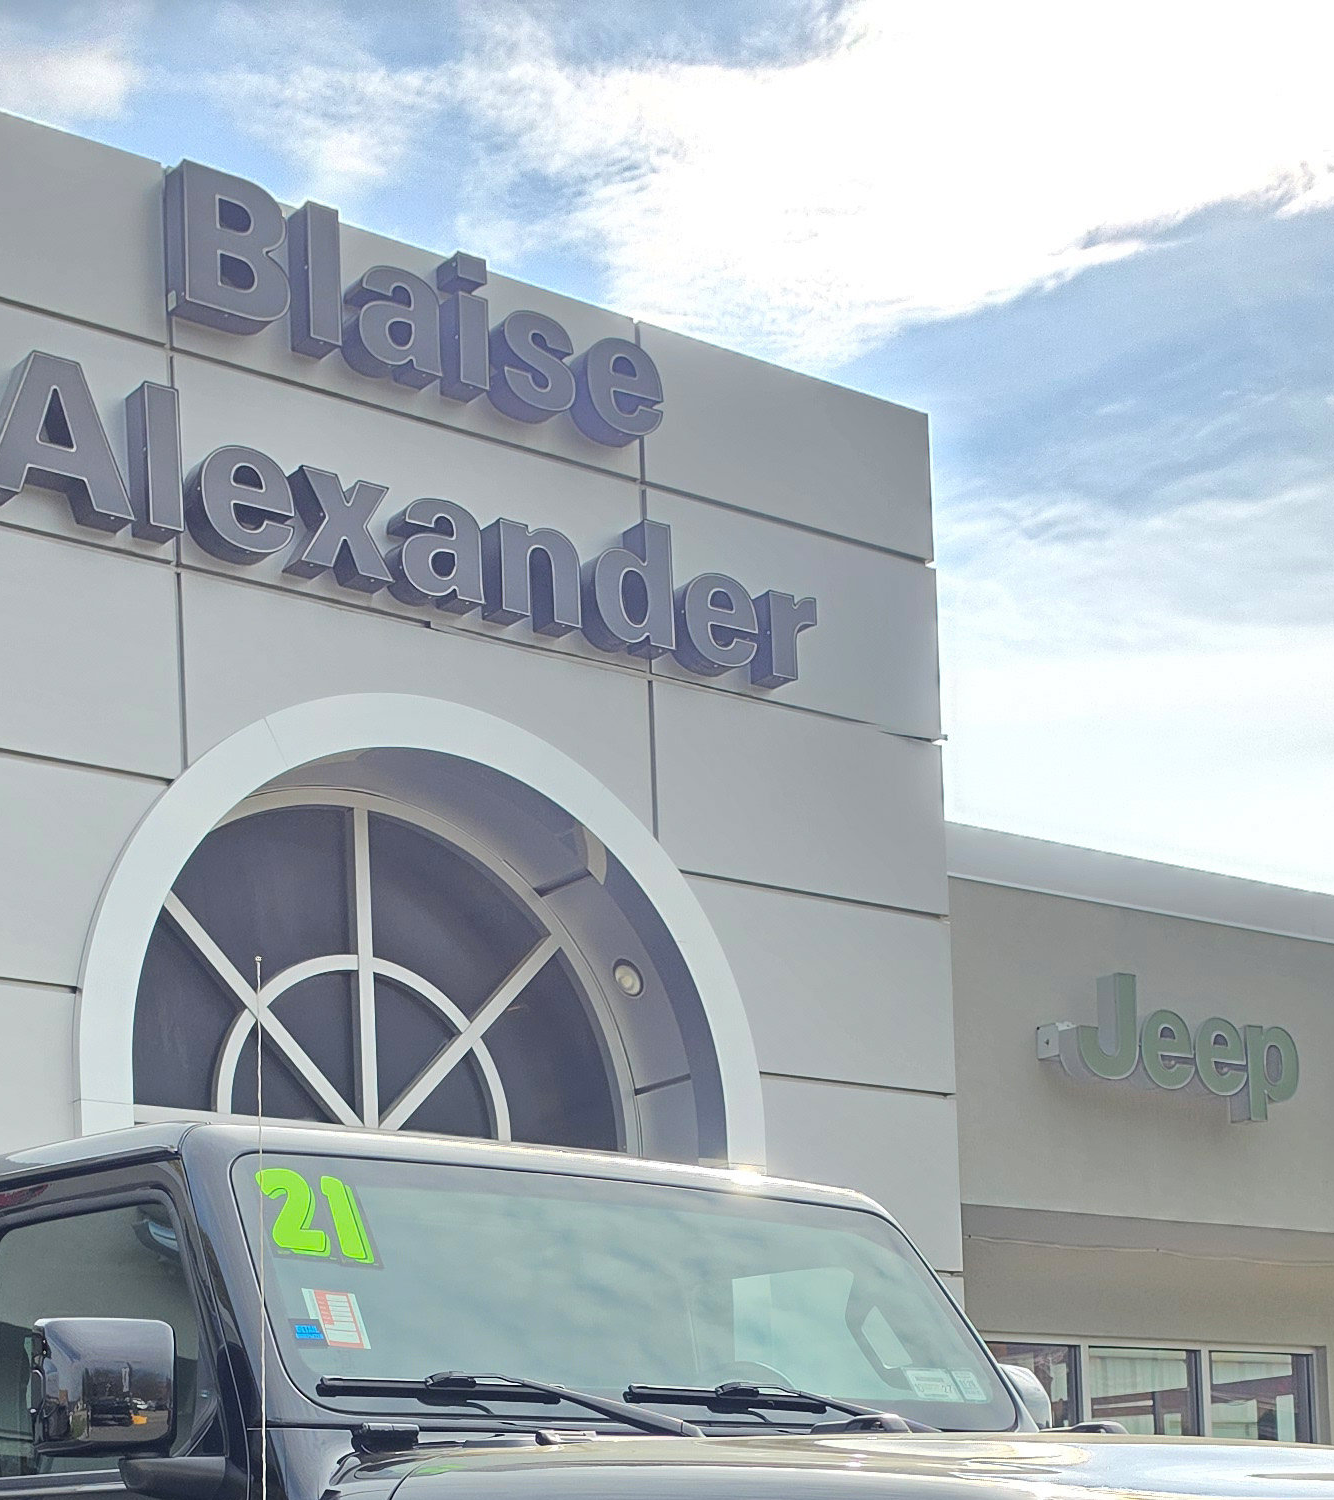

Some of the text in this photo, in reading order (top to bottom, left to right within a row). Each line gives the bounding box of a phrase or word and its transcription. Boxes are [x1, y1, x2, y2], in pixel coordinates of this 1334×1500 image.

[165, 159, 664, 447] Blaise
[1074, 972, 1300, 1123] Jeep
[255, 1168, 375, 1264] 21
